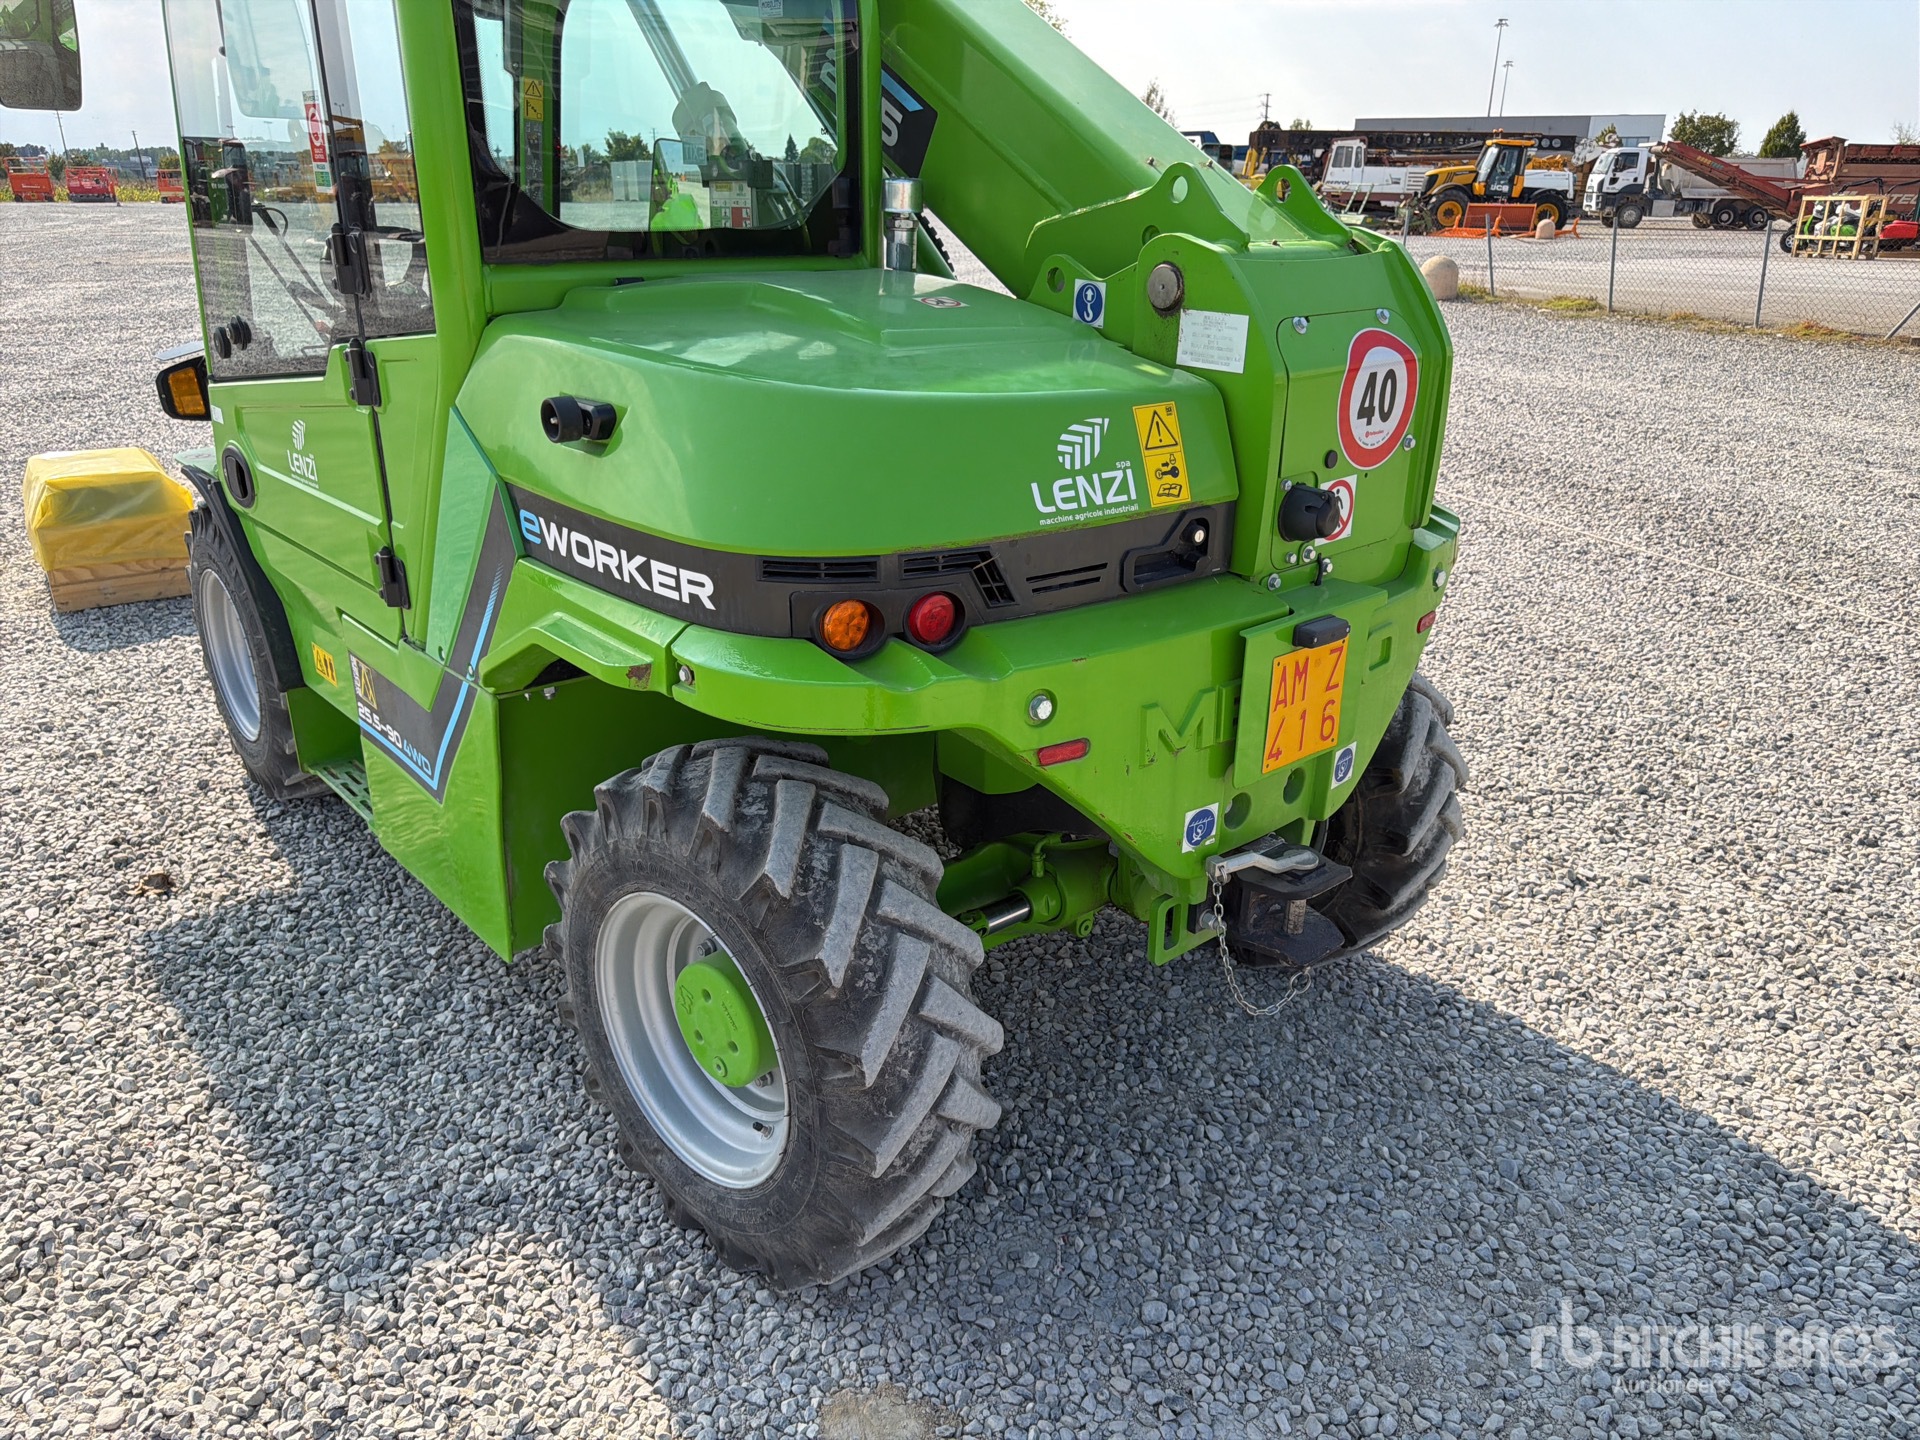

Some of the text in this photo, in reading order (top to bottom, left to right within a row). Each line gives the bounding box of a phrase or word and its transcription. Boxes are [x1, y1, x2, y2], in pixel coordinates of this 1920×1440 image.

[1490, 184, 1509, 193] JCB
[1356, 368, 1398, 426] 40
[286, 449, 318, 481] LENZI
[1115, 460, 1131, 469] spa
[1031, 468, 1137, 513] LENZI
[1039, 503, 1139, 526] macchine agricole industriali
[519, 508, 717, 610] eWORKER
[1273, 656, 1310, 712] AM
[358, 702, 432, 776] 25.5-90 4WD
